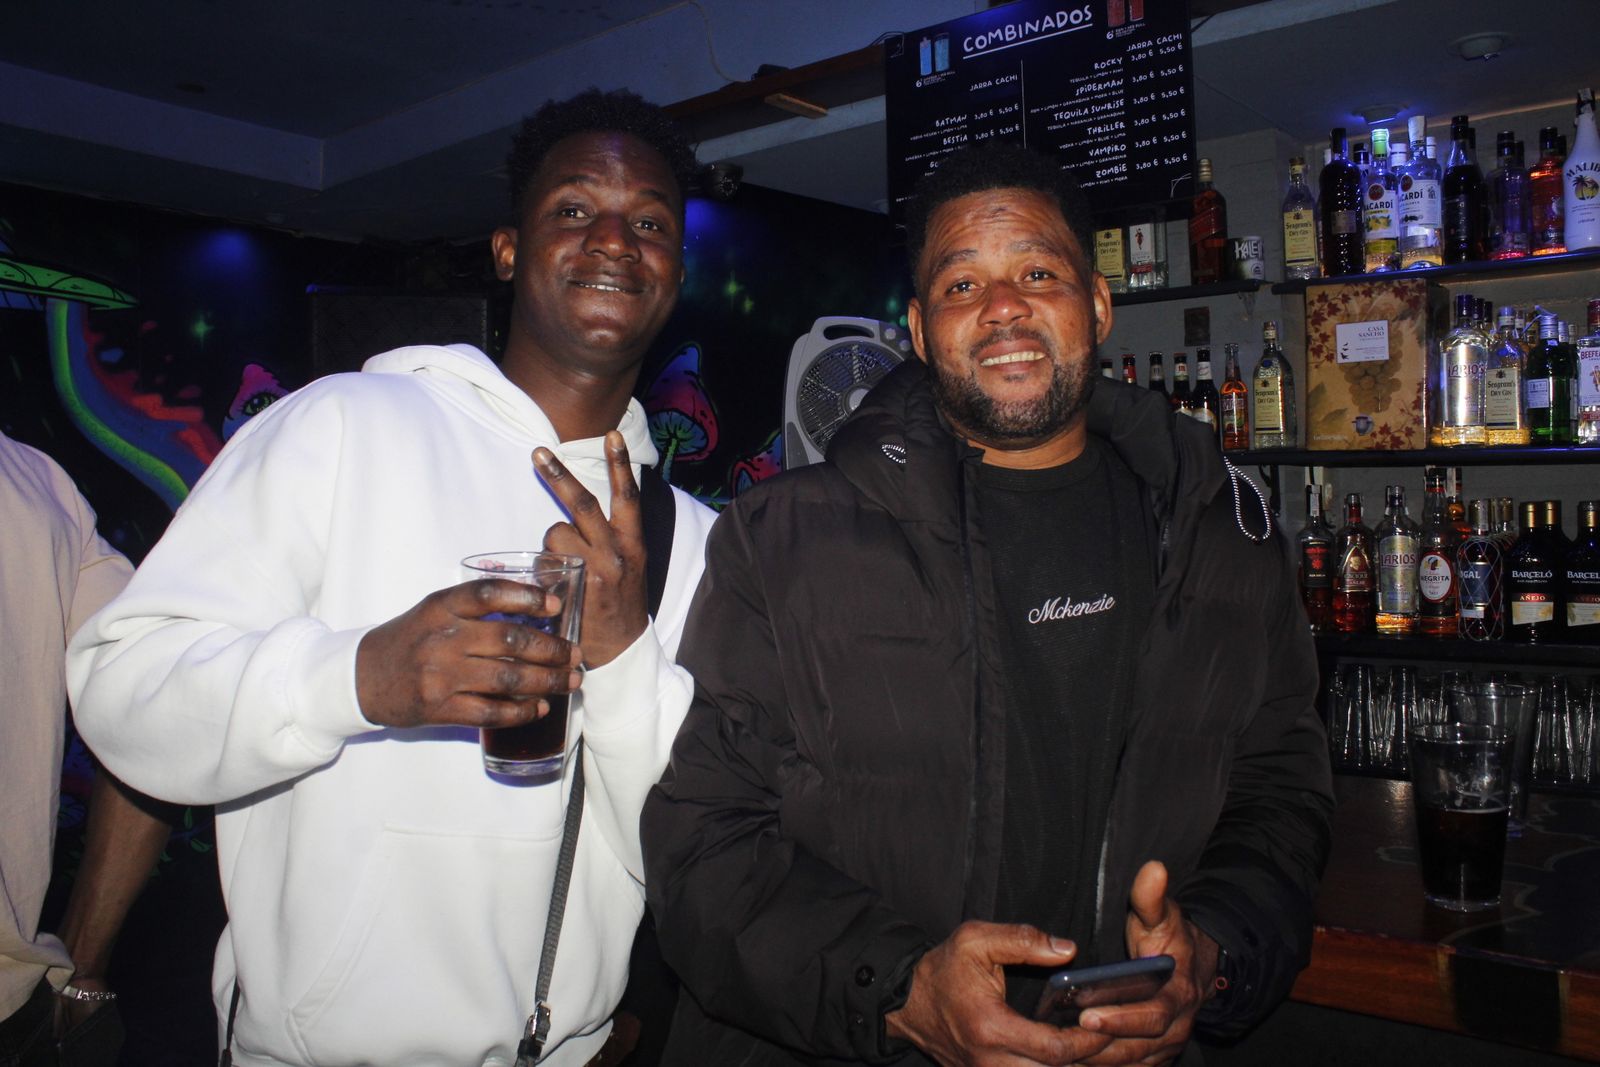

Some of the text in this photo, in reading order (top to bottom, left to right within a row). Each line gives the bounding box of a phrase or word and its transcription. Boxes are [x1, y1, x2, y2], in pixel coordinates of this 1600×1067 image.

[963, 5, 1092, 52] COMBINADOS
[1126, 33, 1182, 52] JARRA CACHI
[1094, 57, 1123, 70] ROCKY
[1160, 46, 1175, 54] 5,50
[970, 74, 1018, 91] JARRA CACHI
[1075, 78, 1124, 96] SPIDERMAN
[1160, 68, 1176, 76] 5,50
[1054, 108, 1089, 120] TEQUILA
[1091, 99, 1124, 113] SUNRISE
[1161, 90, 1177, 99] 5,50
[936, 114, 967, 127] BATMAN
[1087, 122, 1125, 135] THRILLER
[1162, 112, 1178, 120] 5,50
[943, 134, 968, 145] BESTIA
[1089, 144, 1126, 156] VAMPIRO
[1163, 134, 1179, 142] 5,50
[1096, 163, 1127, 178] ZOMBIE
[1164, 156, 1180, 165] 5,50
[1448, 364, 1485, 377] LARIOS
[1381, 554, 1415, 568] LARIOS
[1512, 570, 1552, 579] BARCELÓ
[1028, 593, 1115, 624] Mckenzie
